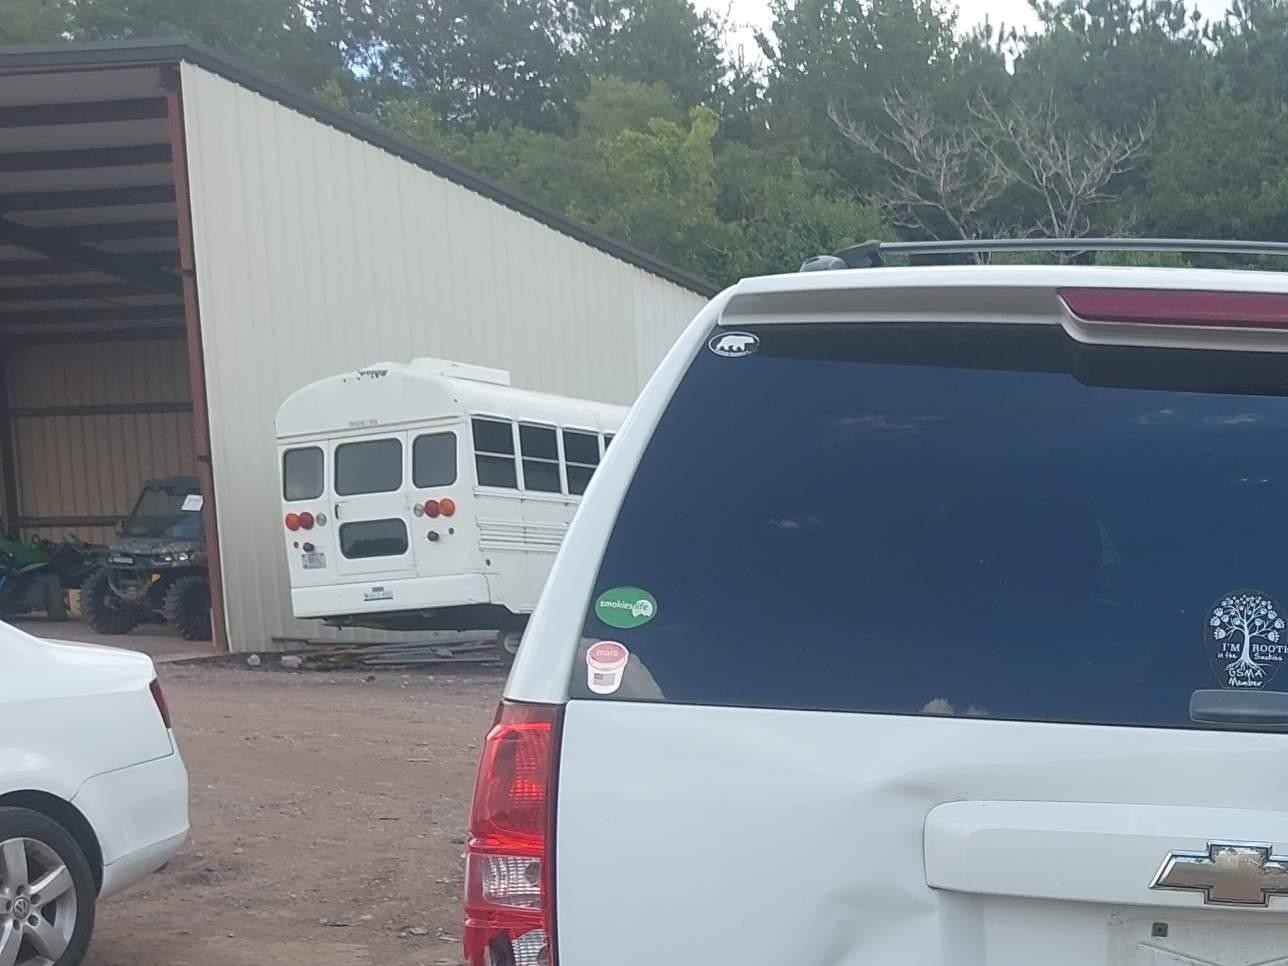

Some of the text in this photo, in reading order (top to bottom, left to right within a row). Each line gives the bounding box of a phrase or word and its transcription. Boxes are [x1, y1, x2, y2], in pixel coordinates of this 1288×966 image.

[1222, 643, 1241, 652] I'M
[1228, 667, 1263, 679] GSMA
[1228, 677, 1263, 687] Member
